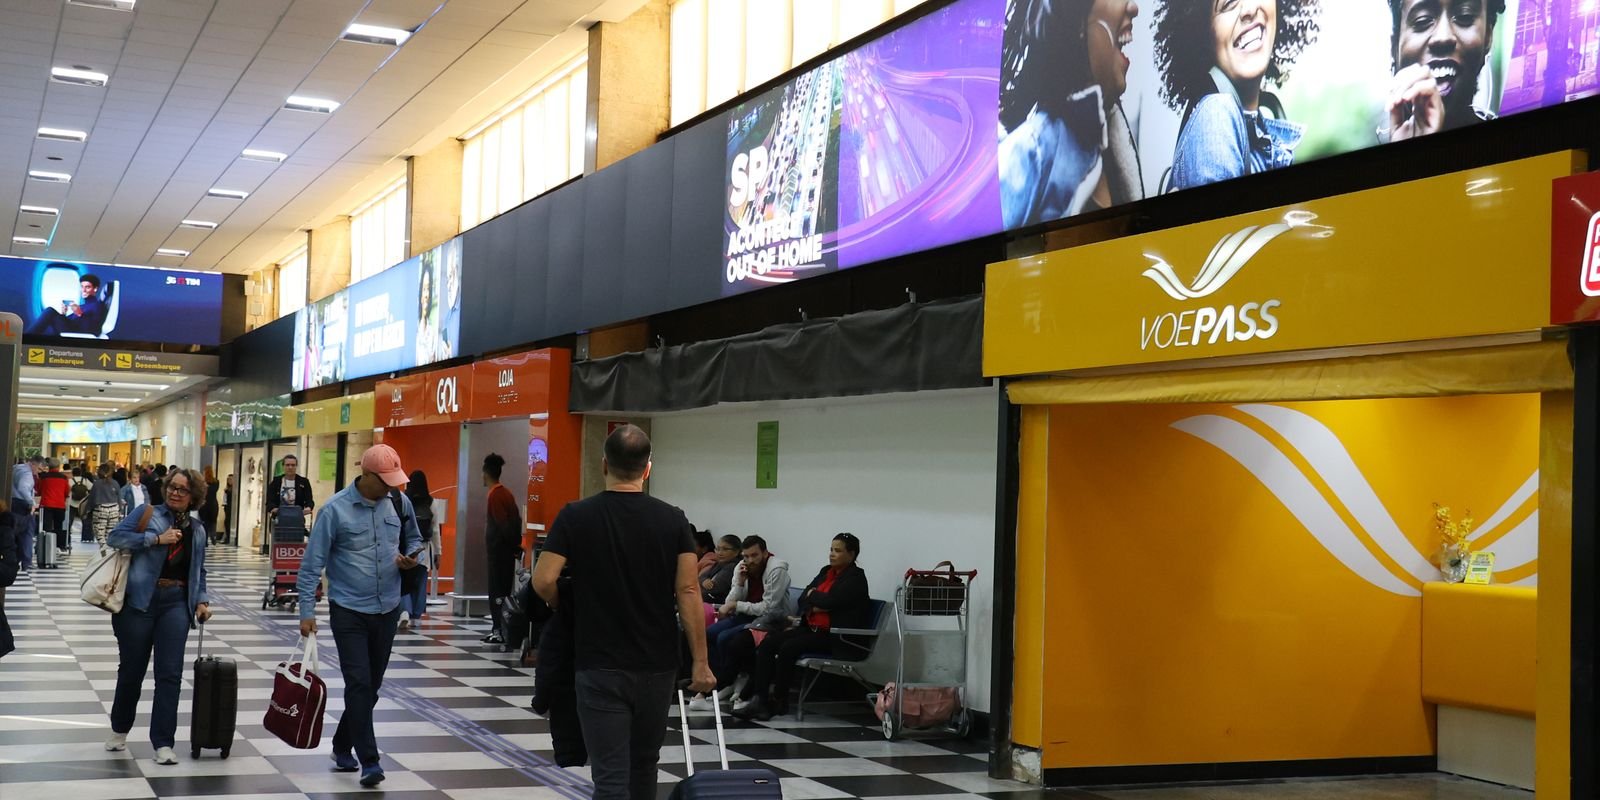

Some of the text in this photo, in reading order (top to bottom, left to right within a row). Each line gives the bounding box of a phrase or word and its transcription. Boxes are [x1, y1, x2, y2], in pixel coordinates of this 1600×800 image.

[731, 145, 768, 207] SP
[727, 212, 802, 256] ACONTECE
[727, 234, 822, 283] OUT OF HOME
[1141, 299, 1281, 350] VOEPASS
[49, 350, 83, 358] Departures
[49, 357, 84, 365] Embarque
[135, 362, 181, 370] Desembarque
[436, 376, 459, 414] GOL
[499, 369, 514, 387] LOJA
